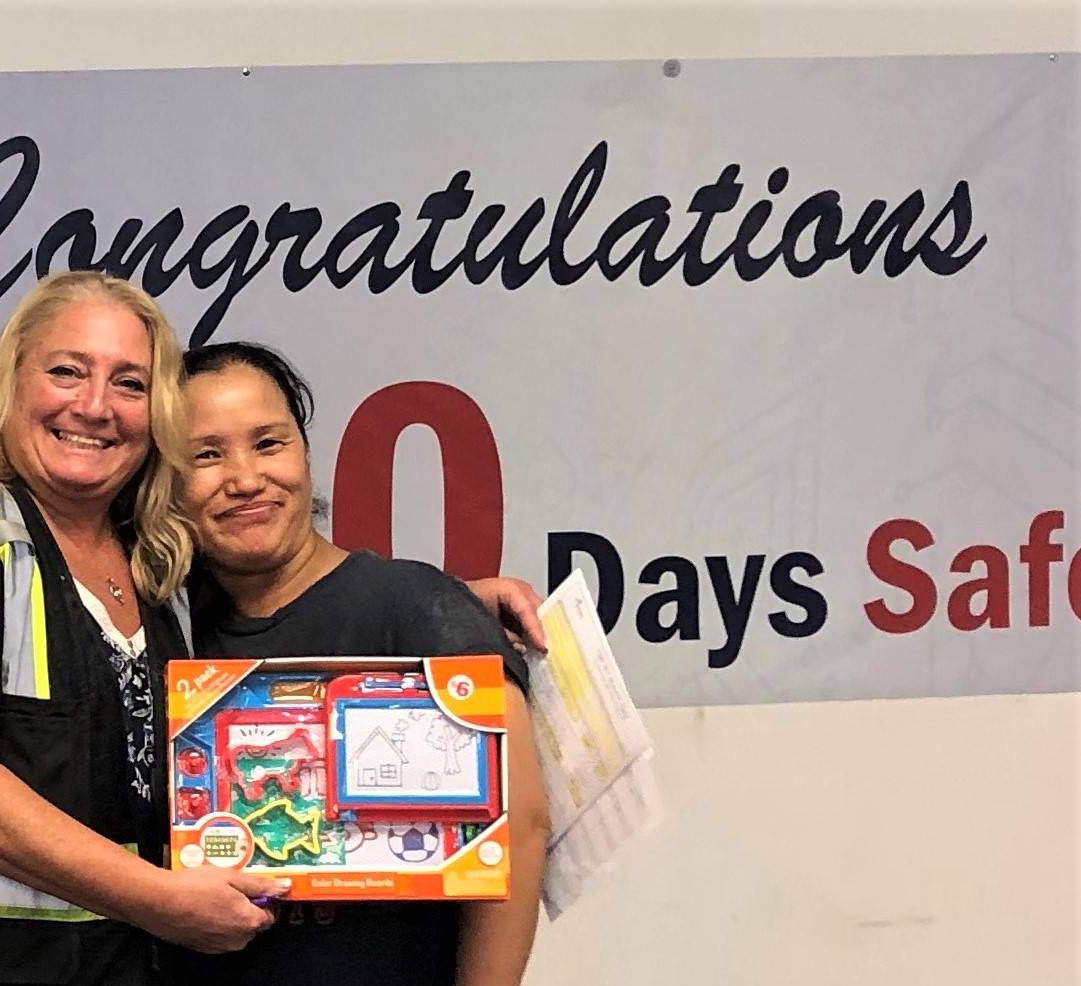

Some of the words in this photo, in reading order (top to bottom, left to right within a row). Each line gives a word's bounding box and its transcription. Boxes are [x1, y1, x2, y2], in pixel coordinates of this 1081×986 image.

[547, 531, 827, 669] Days
[863, 510, 1081, 634] Saf
[177, 679, 197, 700] 2
[194, 665, 220, 689] pack
